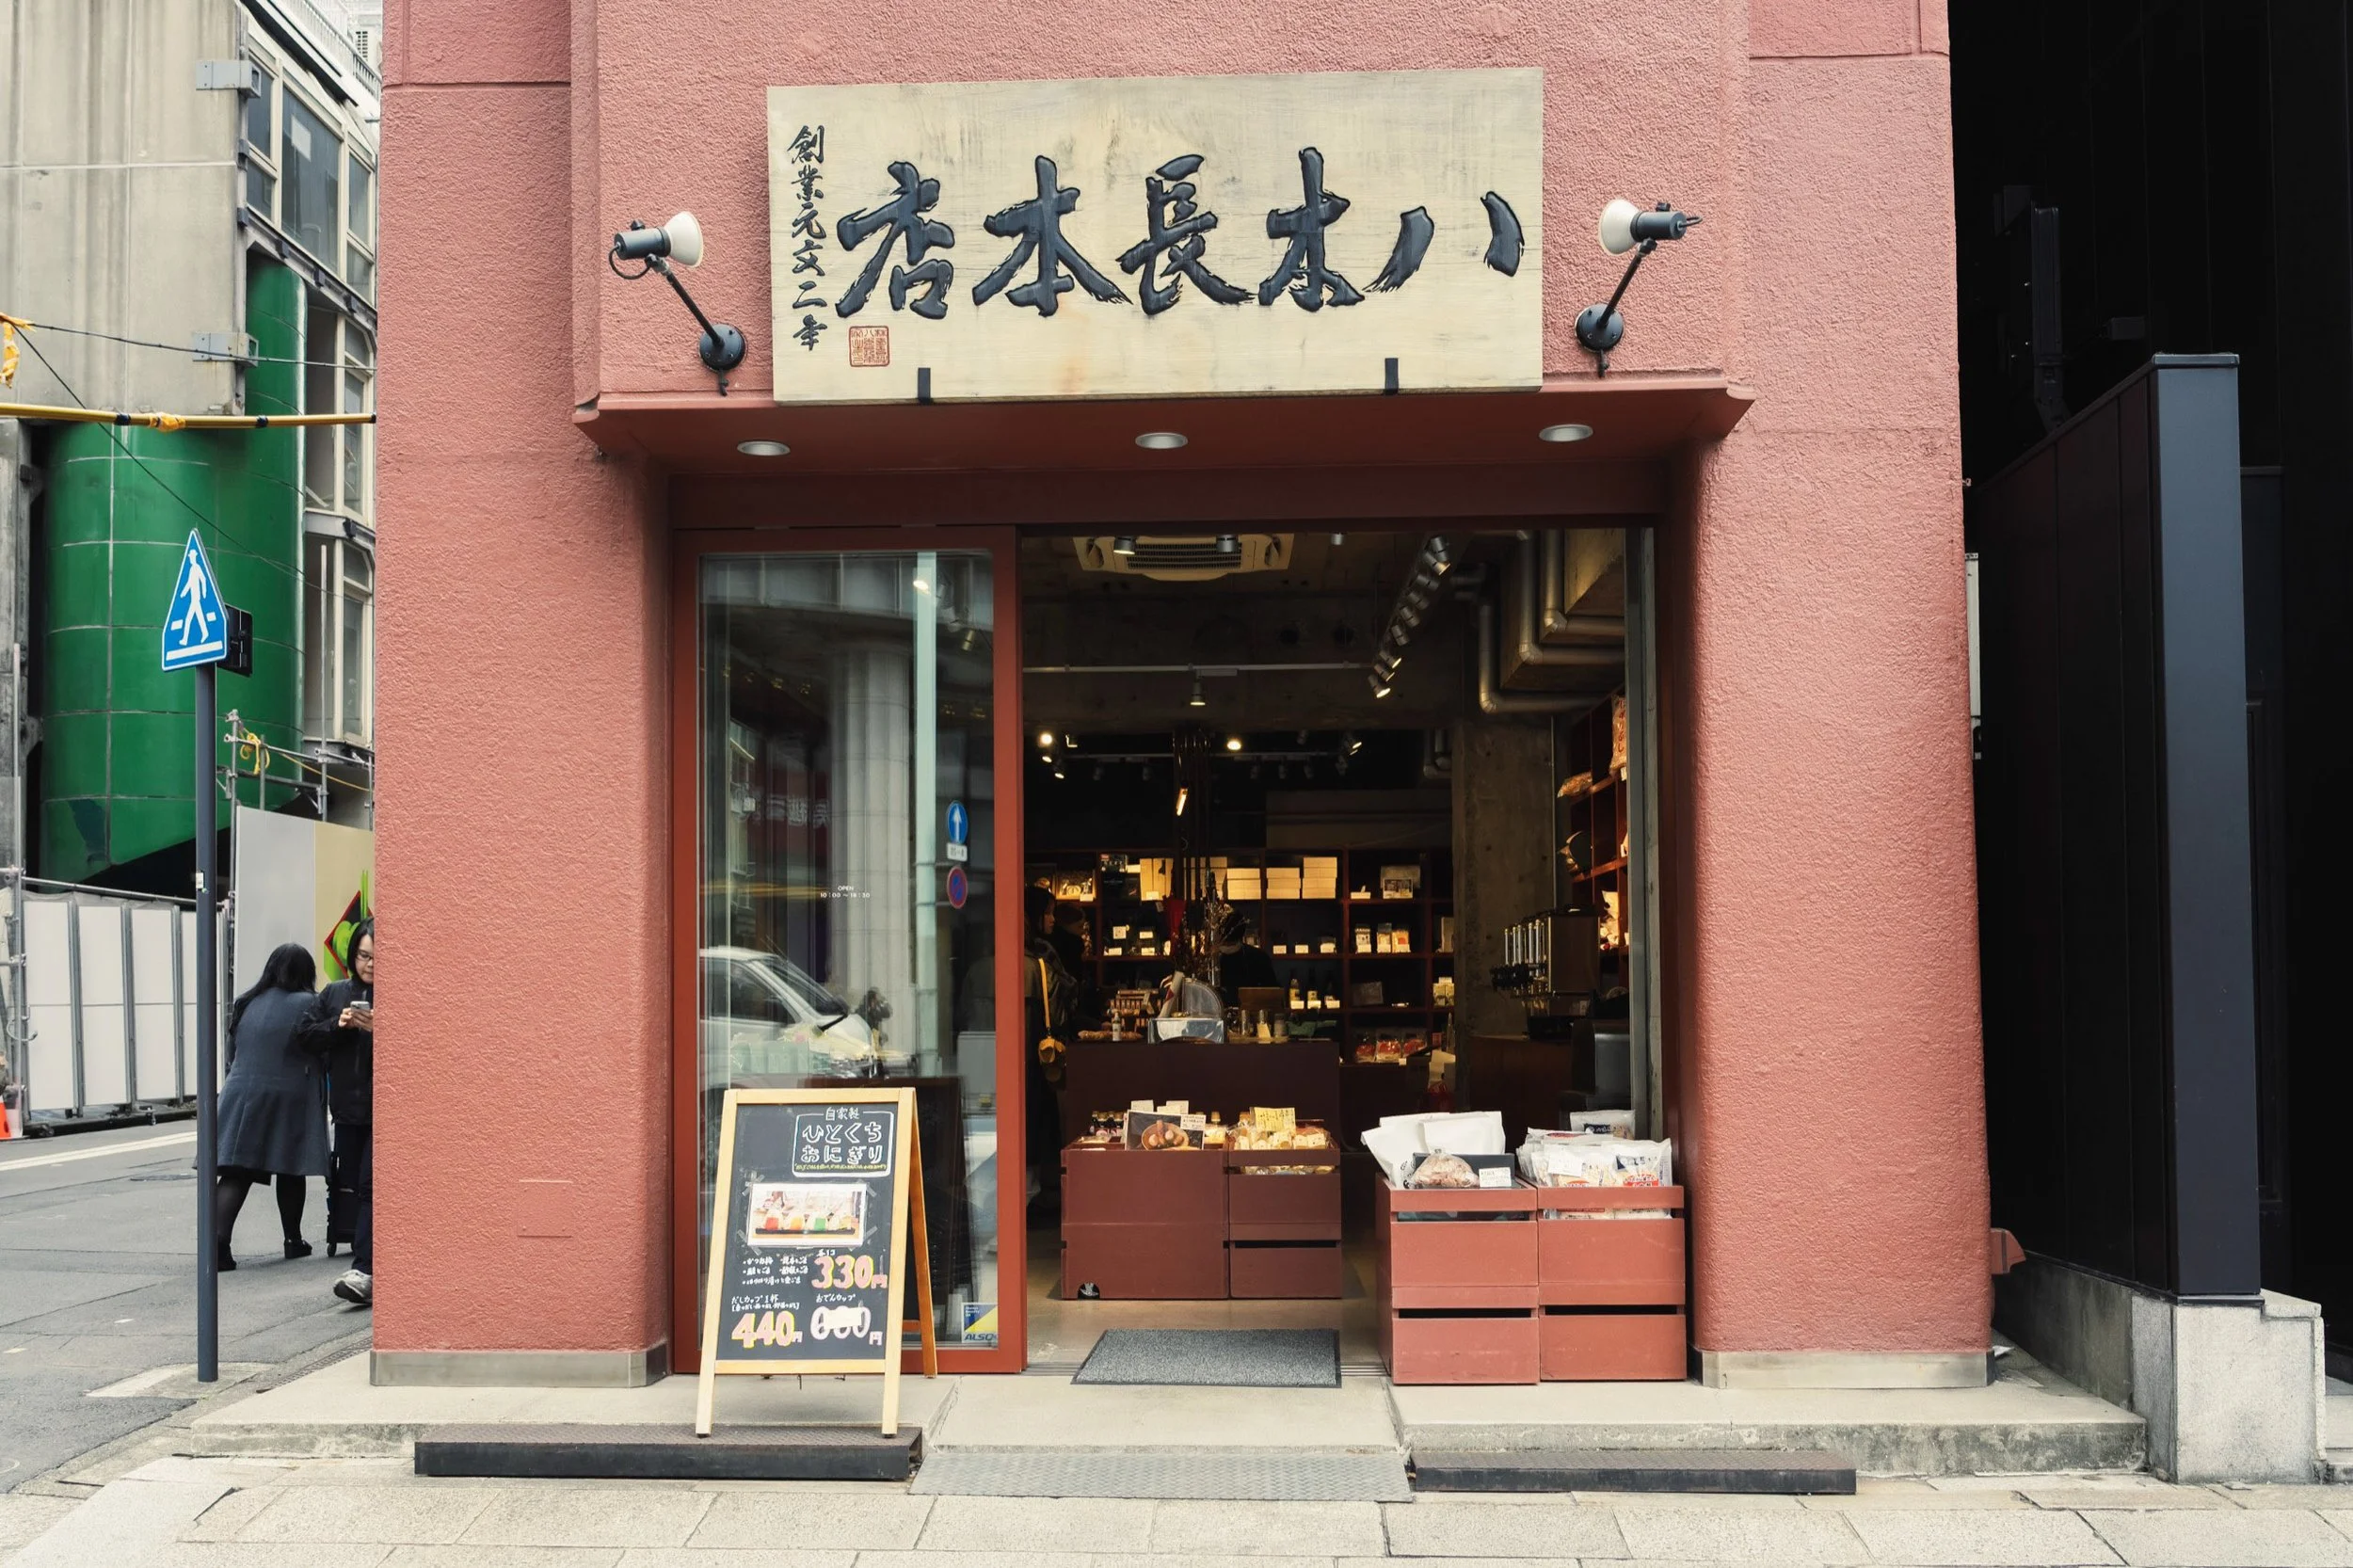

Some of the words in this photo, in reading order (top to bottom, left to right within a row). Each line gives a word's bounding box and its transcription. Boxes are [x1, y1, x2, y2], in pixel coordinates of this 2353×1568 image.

[825, 1107, 860, 1121] 自家製
[802, 1122, 882, 1144] ひとくち
[800, 1144, 884, 1165] おにぎり
[811, 1254, 888, 1289] 330円
[815, 1293, 856, 1304] おでんカップ
[730, 1309, 803, 1349] 440円
